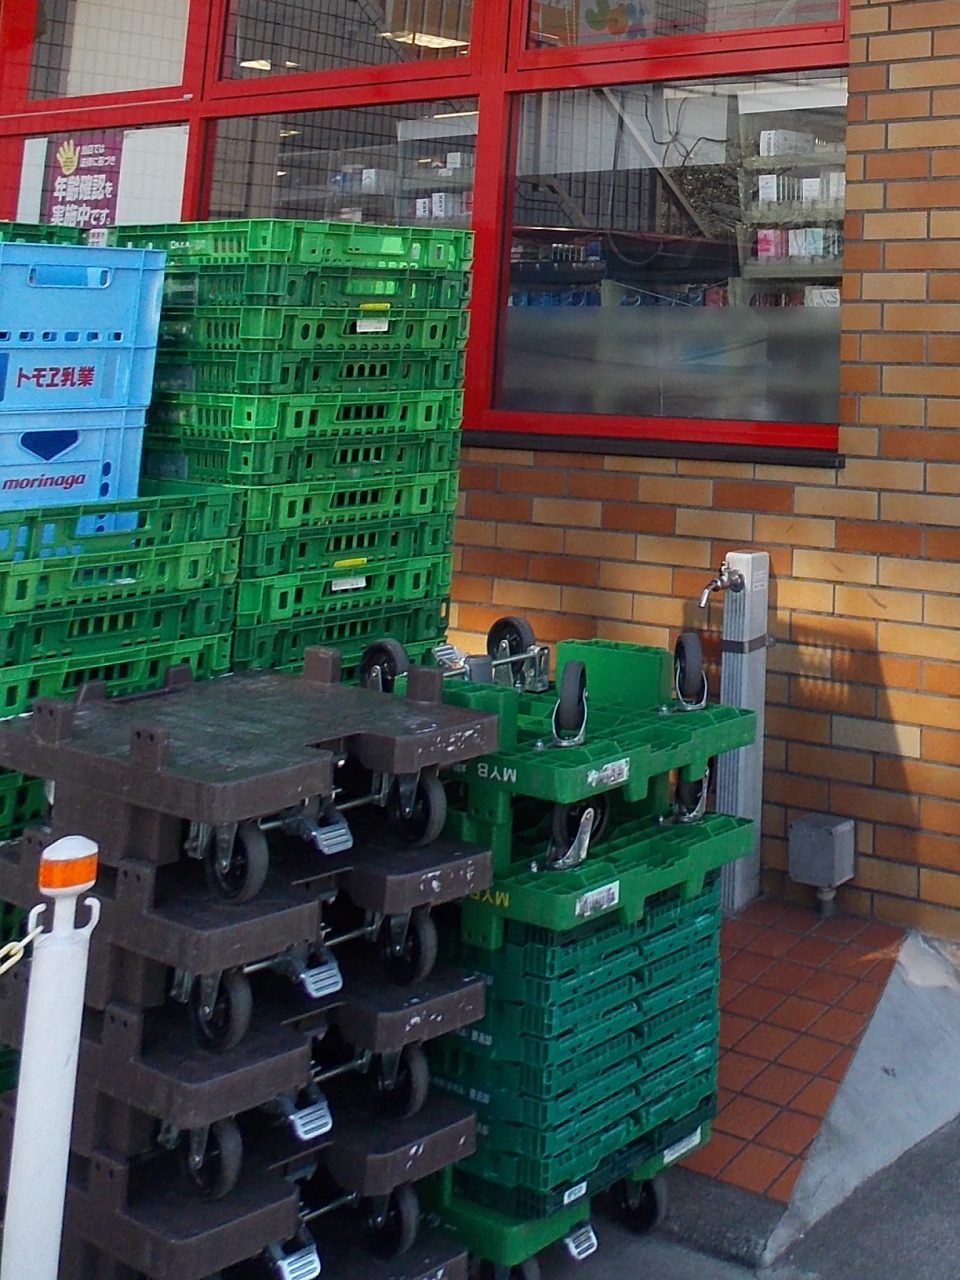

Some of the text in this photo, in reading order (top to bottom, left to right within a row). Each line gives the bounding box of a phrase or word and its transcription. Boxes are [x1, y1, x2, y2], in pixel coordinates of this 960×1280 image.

[53, 174, 113, 202] 年齢確認を
[51, 203, 111, 227] 実施中です。
[2, 474, 86, 490] morinaga
